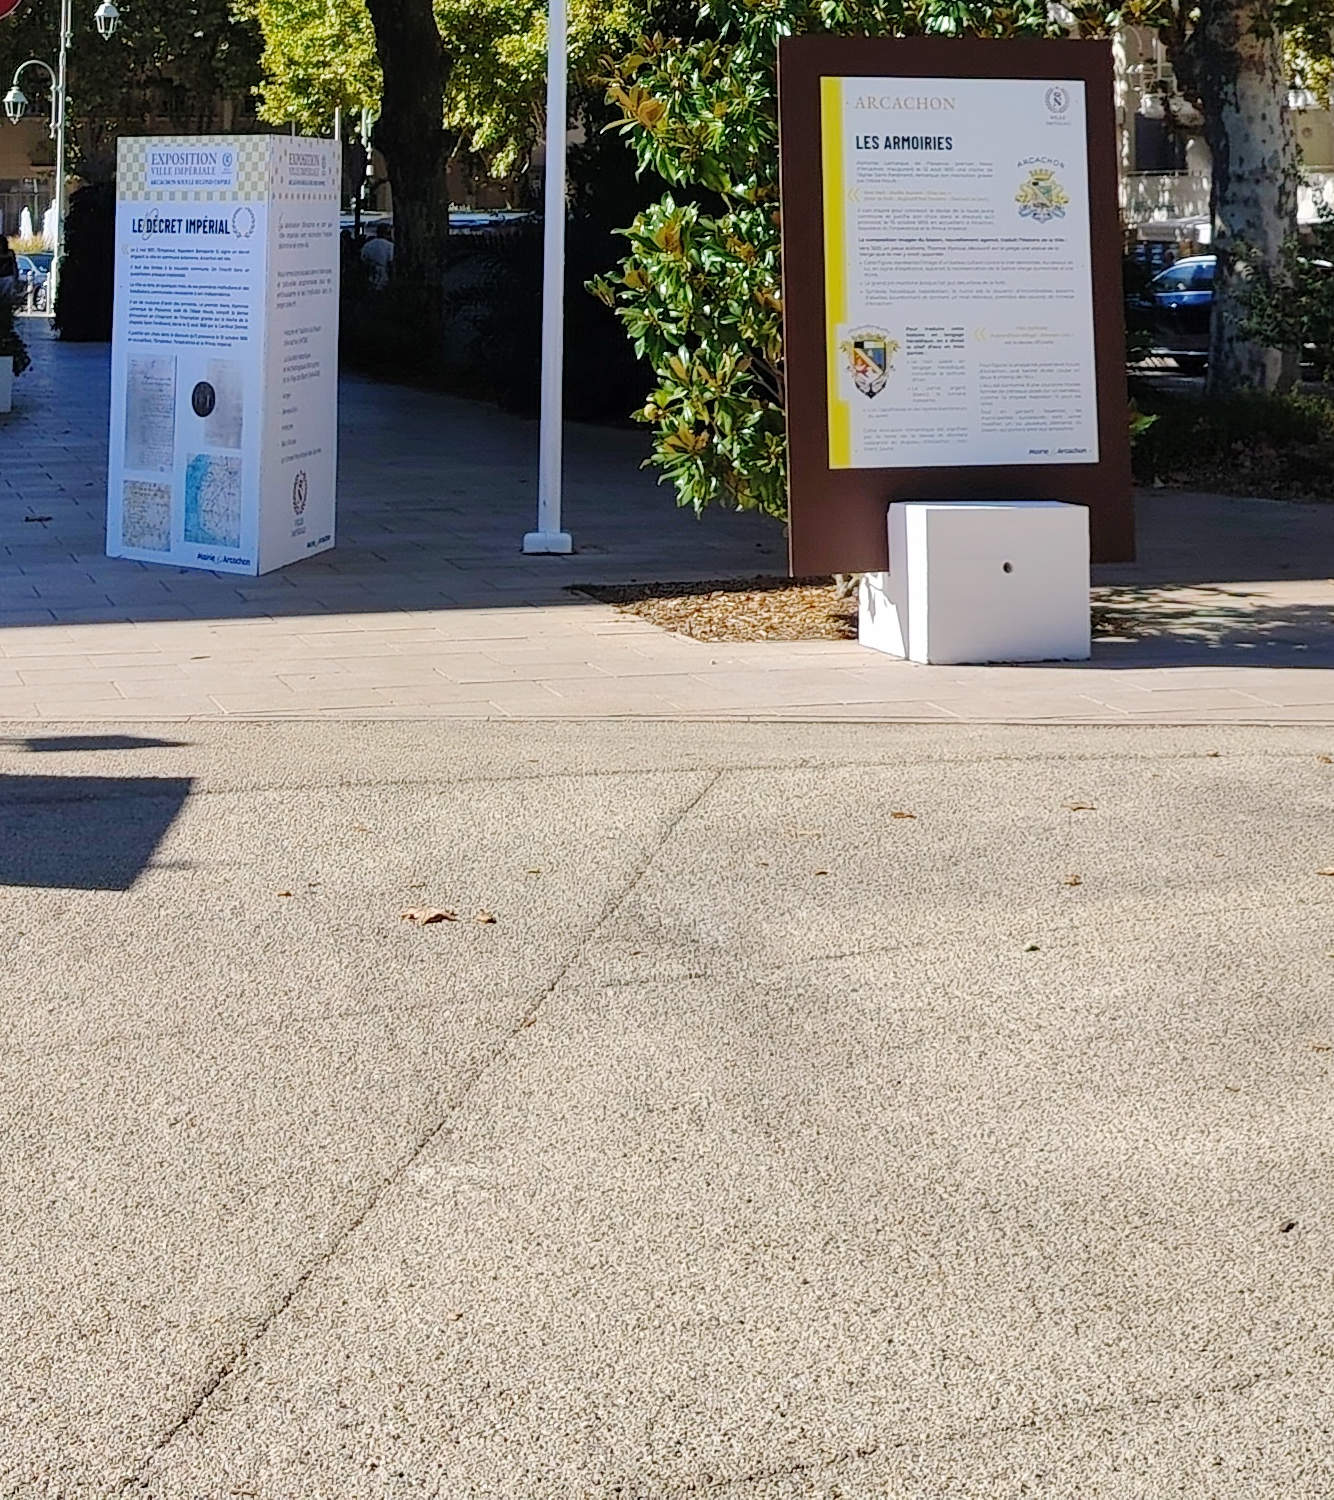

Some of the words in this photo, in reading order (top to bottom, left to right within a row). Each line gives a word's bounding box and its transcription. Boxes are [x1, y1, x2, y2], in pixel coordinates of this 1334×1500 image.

[854, 96, 955, 110] ARCACHON
[855, 134, 879, 150] LES
[883, 136, 953, 150] ARMOIRIES
[151, 152, 217, 166] EXPOSITION
[151, 166, 173, 176] VILLE
[175, 166, 216, 176] IMPÉRIALE
[132, 218, 144, 234] LE
[146, 214, 183, 234] DÉCRET
[185, 215, 231, 234] IMPÉRIAL
